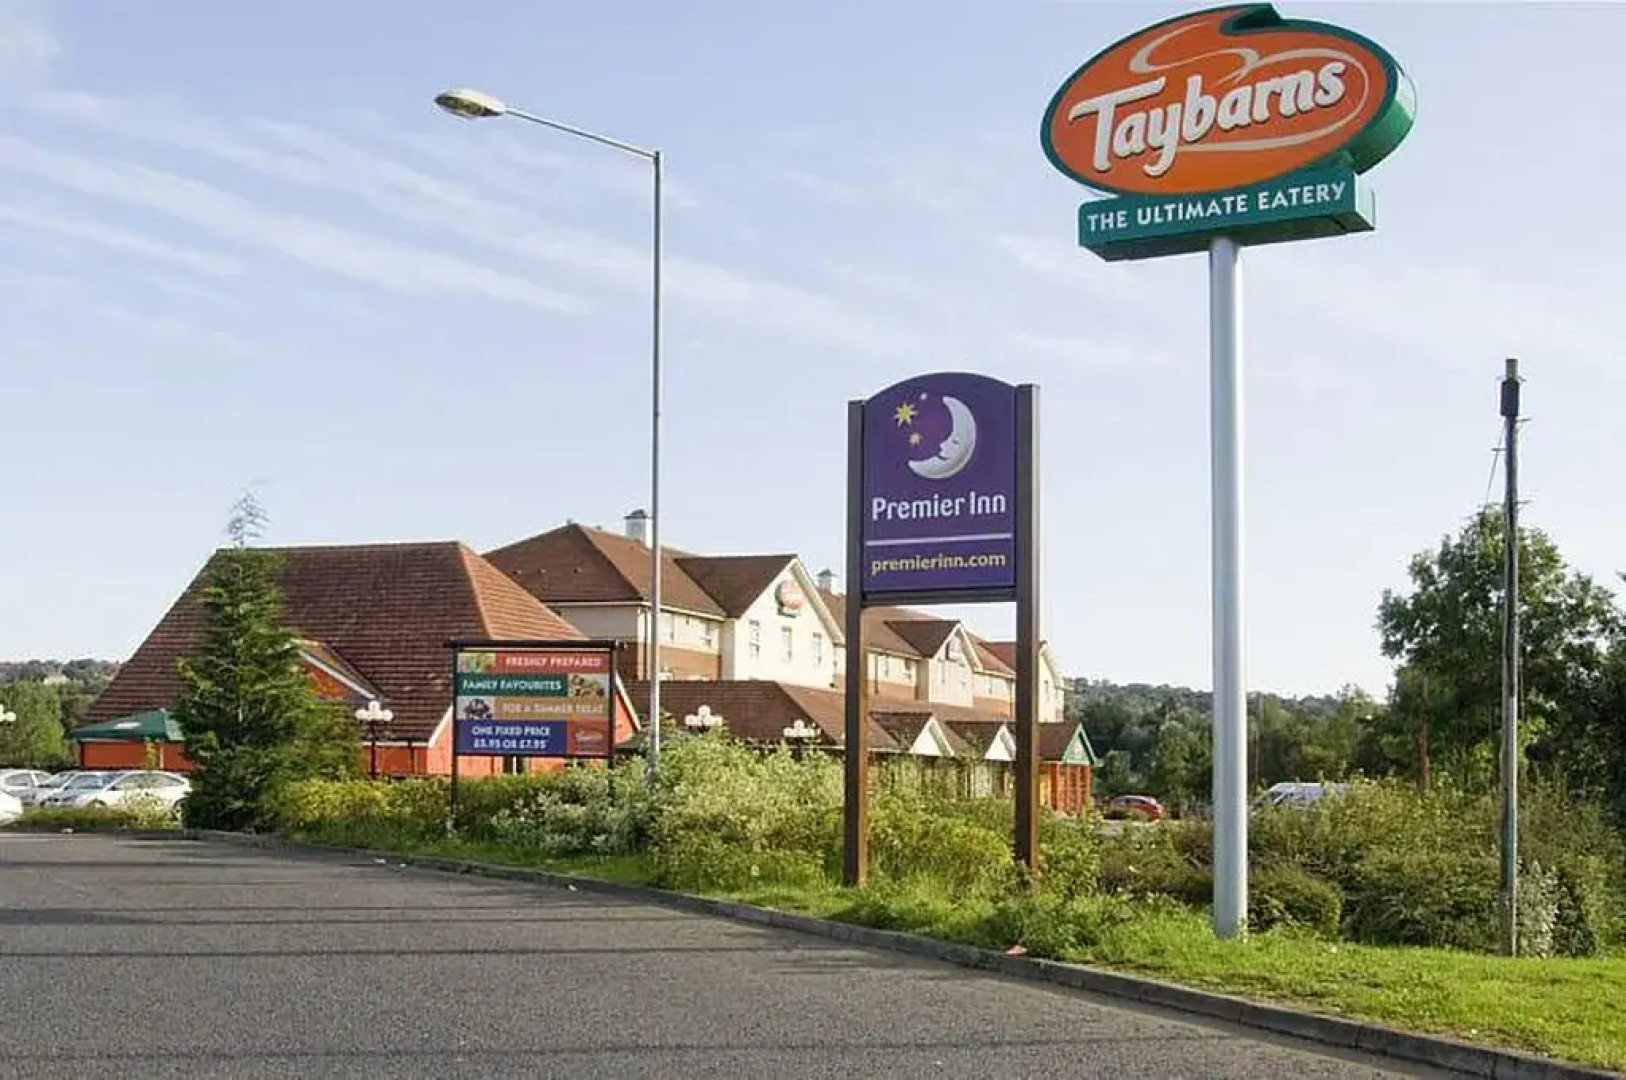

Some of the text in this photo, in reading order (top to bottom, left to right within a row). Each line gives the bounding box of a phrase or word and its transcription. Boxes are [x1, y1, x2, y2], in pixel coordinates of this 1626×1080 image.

[1068, 61, 1346, 178] Taybarns
[1087, 182, 1346, 232] THE ULTIMATE EATERY
[871, 491, 1006, 521] Premier Inn
[870, 552, 1006, 576] premierinn.com
[505, 657, 547, 668] FRESHLY
[463, 679, 562, 690] FAMILY FAVOURITES
[471, 725, 551, 736] ONE FIXED PRICE
[502, 739, 518, 749] OR
